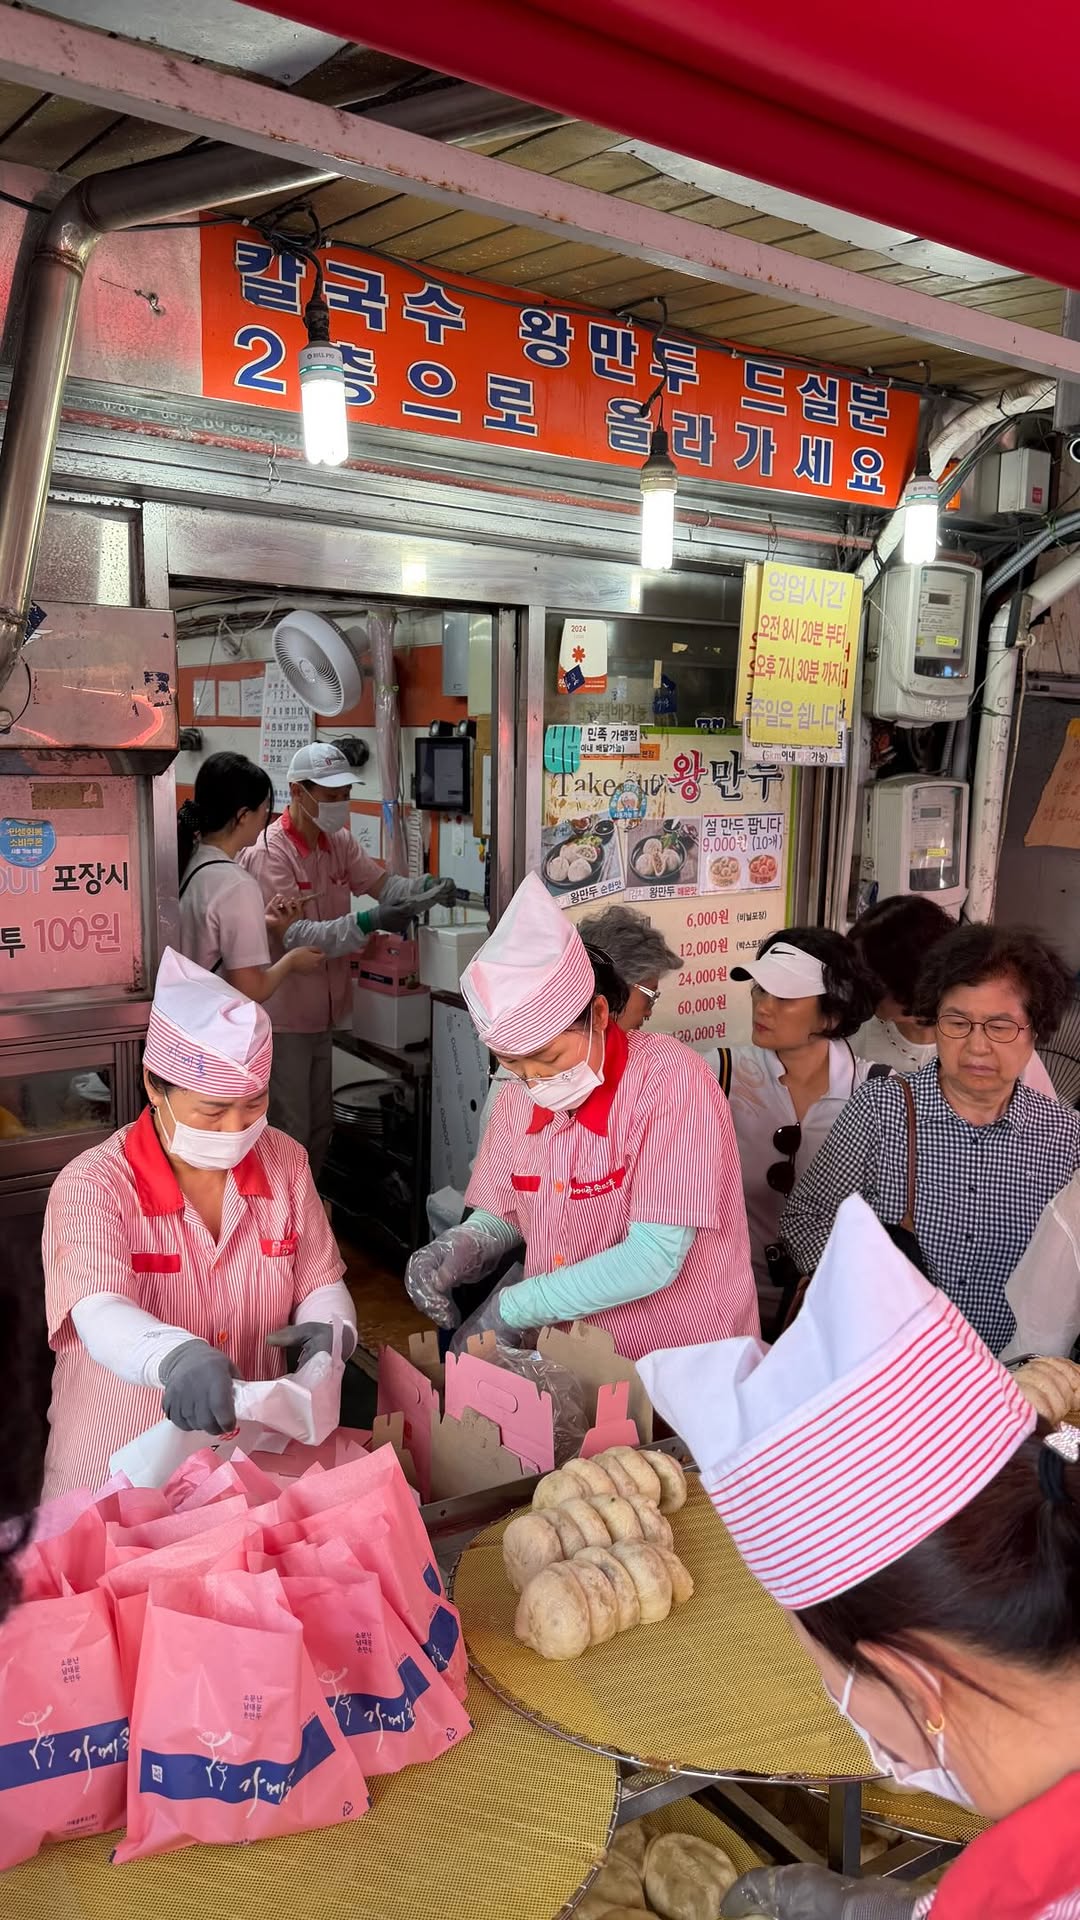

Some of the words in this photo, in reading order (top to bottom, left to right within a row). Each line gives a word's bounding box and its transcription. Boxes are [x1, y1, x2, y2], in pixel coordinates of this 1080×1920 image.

[234, 239, 467, 346] 칼국수
[519, 307, 700, 396] 왕만두
[740, 359, 890, 437] 드실분
[605, 395, 887, 495] 올라가세요
[768, 570, 846, 610] 영업시간
[571, 624, 587, 633] 2024
[758, 614, 780, 642] 오전
[782, 617, 799, 644] 8시
[800, 621, 824, 646] 20분
[825, 623, 847, 649] 부터
[755, 654, 776, 679] 오후
[779, 657, 795, 683] 7시
[797, 659, 819, 685] 30분
[822, 661, 843, 688] 까지
[752, 698, 794, 729] 주일은
[797, 702, 840, 731] 쉽니다
[587, 727, 608, 741] 민족
[611, 730, 638, 741] 가맹점
[552, 772, 616, 798] Take
[667, 751, 785, 802] 왕만두
[705, 818, 717, 837] 설
[720, 818, 745, 836] 만두
[747, 816, 782, 835] 팝니다
[702, 834, 747, 853] 9,000원
[752, 834, 783, 852] (10개)
[52, 861, 129, 896] 포장시
[570, 885, 599, 904] 왕만두
[600, 879, 622, 895] 순한맛
[649, 885, 675, 898] 왕만두
[677, 886, 697, 897] 매운맛
[686, 909, 729, 928] 6,000원
[736, 910, 767, 923] (비닐포장)
[33, 912, 121, 954] 100원
[679, 937, 729, 958] 12,000원
[678, 966, 728, 987] 24,000원
[677, 994, 728, 1016] 60,000원
